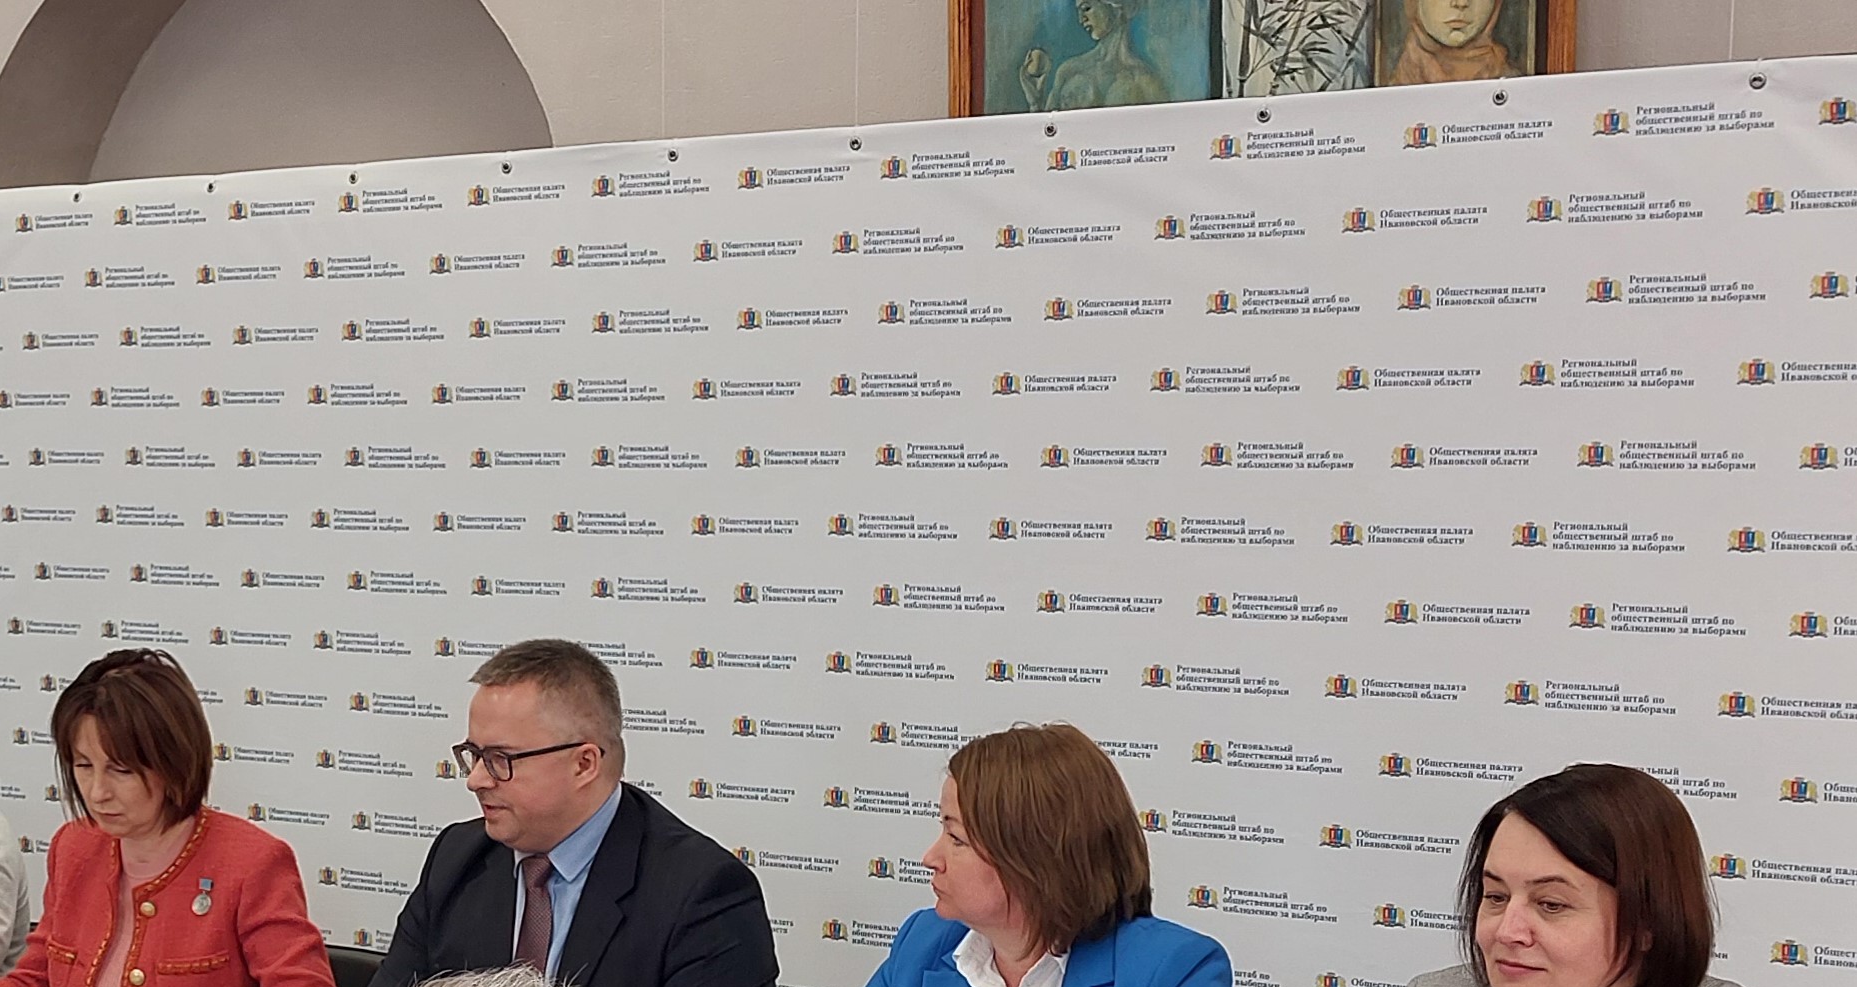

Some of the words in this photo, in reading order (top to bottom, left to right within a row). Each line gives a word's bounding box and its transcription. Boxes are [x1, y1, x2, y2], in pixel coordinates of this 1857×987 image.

[1636, 102, 1715, 115] Региональный
[1635, 113, 1715, 126] общественный
[1718, 109, 1746, 121] штаб
[1442, 123, 1515, 134] Общественная
[1518, 120, 1553, 129] палата
[1635, 125, 1702, 136] наблюдению
[1719, 120, 1775, 131] выборами
[1442, 131, 1501, 145] Ивановской
[1504, 130, 1544, 140] области
[1569, 191, 1645, 204] Региональный
[1568, 201, 1645, 213] общественный
[1648, 199, 1676, 210] штаб
[1380, 208, 1451, 220] Общественная
[1453, 206, 1487, 215] палата
[1568, 213, 1633, 223] наблюдению
[1649, 209, 1703, 220] выборами
[1380, 217, 1438, 229] Ивановской
[1440, 216, 1479, 226] области
[1629, 273, 1707, 284] Региональный
[1436, 287, 1509, 297] Общественная
[1511, 286, 1546, 295] палата
[1628, 283, 1707, 294] общественный
[1710, 281, 1738, 292] штаб
[1436, 296, 1495, 307] Ивановской
[1498, 295, 1537, 305] области
[1628, 294, 1694, 305] наблюдению
[1711, 292, 1766, 303] выборами
[1561, 358, 1637, 368] Региональный
[1374, 368, 1444, 378] Общественная
[1447, 369, 1481, 377] палата
[1560, 368, 1637, 378] общественный
[1640, 367, 1668, 377] штаб
[1374, 378, 1431, 388] Ивановской
[1434, 377, 1472, 387] области
[1560, 379, 1625, 388] наблюдению
[1641, 377, 1694, 388] выборами
[1429, 447, 1501, 456] Общественная
[1620, 441, 1697, 450] Региональный
[1429, 456, 1488, 466] Ивановской
[1490, 456, 1529, 466] области
[1619, 450, 1697, 460] общественный
[1700, 450, 1728, 460] штаб
[1619, 460, 1685, 470] наблюдению
[1701, 460, 1756, 471] выборами
[1367, 525, 1437, 535] Общественная
[1553, 521, 1628, 531] Региональный
[1368, 534, 1425, 544] Ивановской
[1427, 535, 1465, 545] области
[1552, 531, 1628, 541] общественный
[1631, 532, 1658, 542] штаб
[1552, 541, 1616, 551] наблюдению
[1632, 542, 1685, 553] выборами
[1422, 603, 1494, 614] Общественная
[1496, 607, 1530, 616] палата
[1612, 603, 1688, 614] Региональный
[1422, 613, 1480, 624] Ивановской
[1483, 615, 1521, 625] области
[1611, 613, 1688, 624] общественный
[1691, 615, 1719, 625] штаб
[1611, 623, 1676, 634] наблюдению
[1692, 626, 1746, 636] выборами
[1361, 678, 1431, 690] Общественная
[1433, 683, 1466, 692] палата
[1546, 680, 1620, 692] Региональный
[1361, 687, 1418, 699] Ивановской
[1420, 690, 1458, 701] области
[1545, 690, 1620, 702] общественный
[1623, 694, 1649, 704] штаб
[1545, 700, 1608, 711] наблюдению
[1623, 704, 1676, 715] выборами
[1416, 758, 1487, 770] Общественная
[1490, 764, 1523, 773] палата
[1416, 767, 1474, 779] Ивановской
[1476, 772, 1514, 782] области
[1356, 829, 1425, 843] Общественная
[1427, 836, 1460, 846] палата
[1356, 838, 1412, 851] Ивановской
[1414, 843, 1451, 854] области
[1752, 858, 1832, 875] Общественная
[1752, 869, 1817, 884] Ивановской
